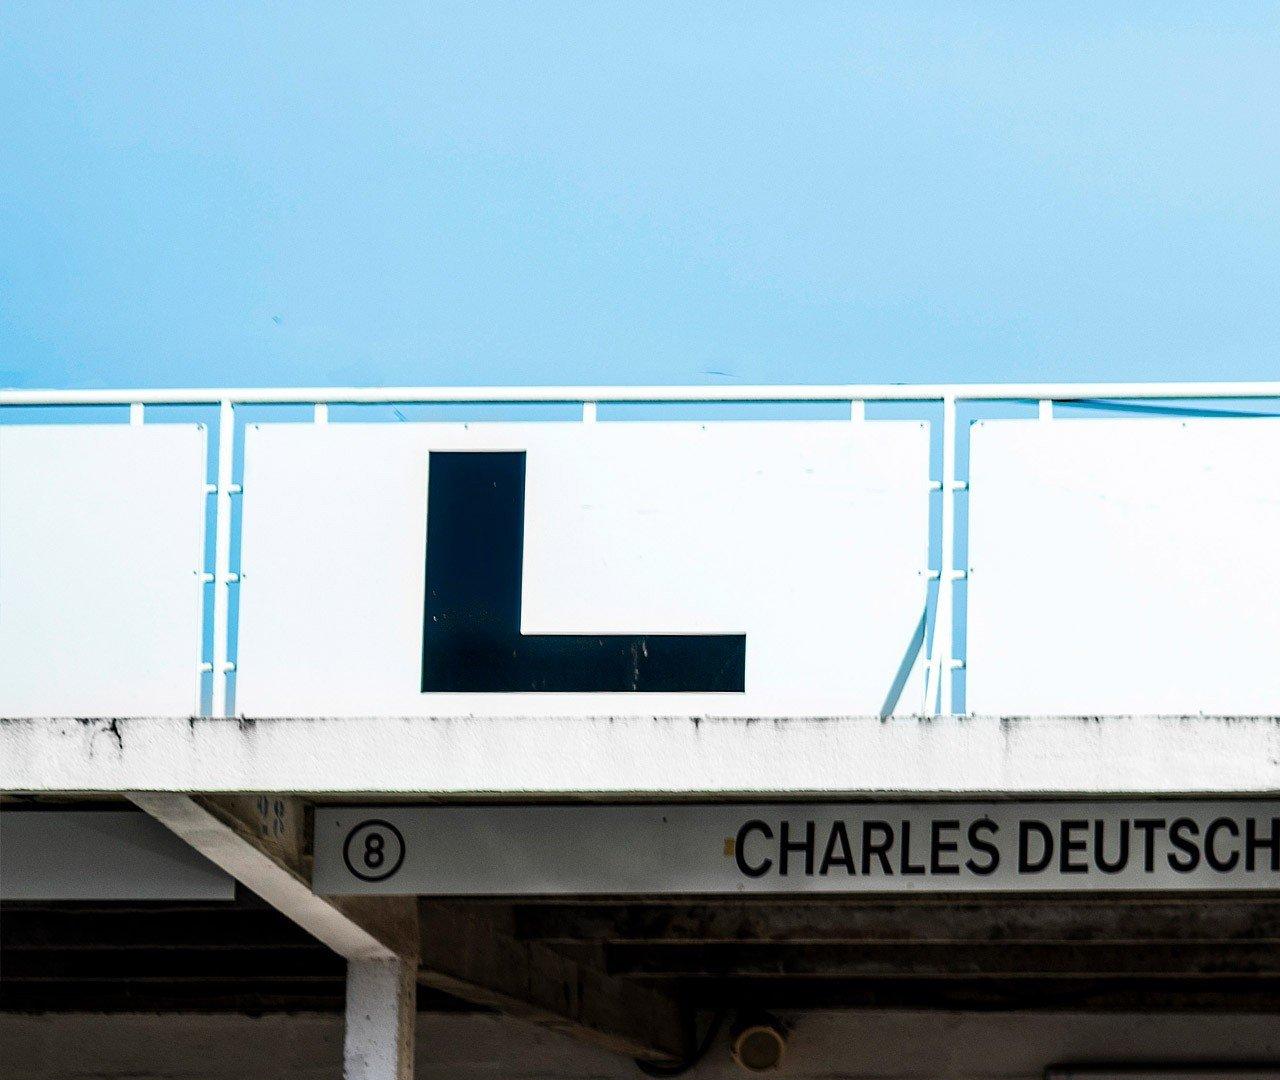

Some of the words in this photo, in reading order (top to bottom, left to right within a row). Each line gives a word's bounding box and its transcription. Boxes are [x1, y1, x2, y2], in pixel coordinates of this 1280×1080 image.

[421, 450, 746, 694] L
[363, 832, 386, 870] 8
[735, 818, 1000, 878] CHARLES
